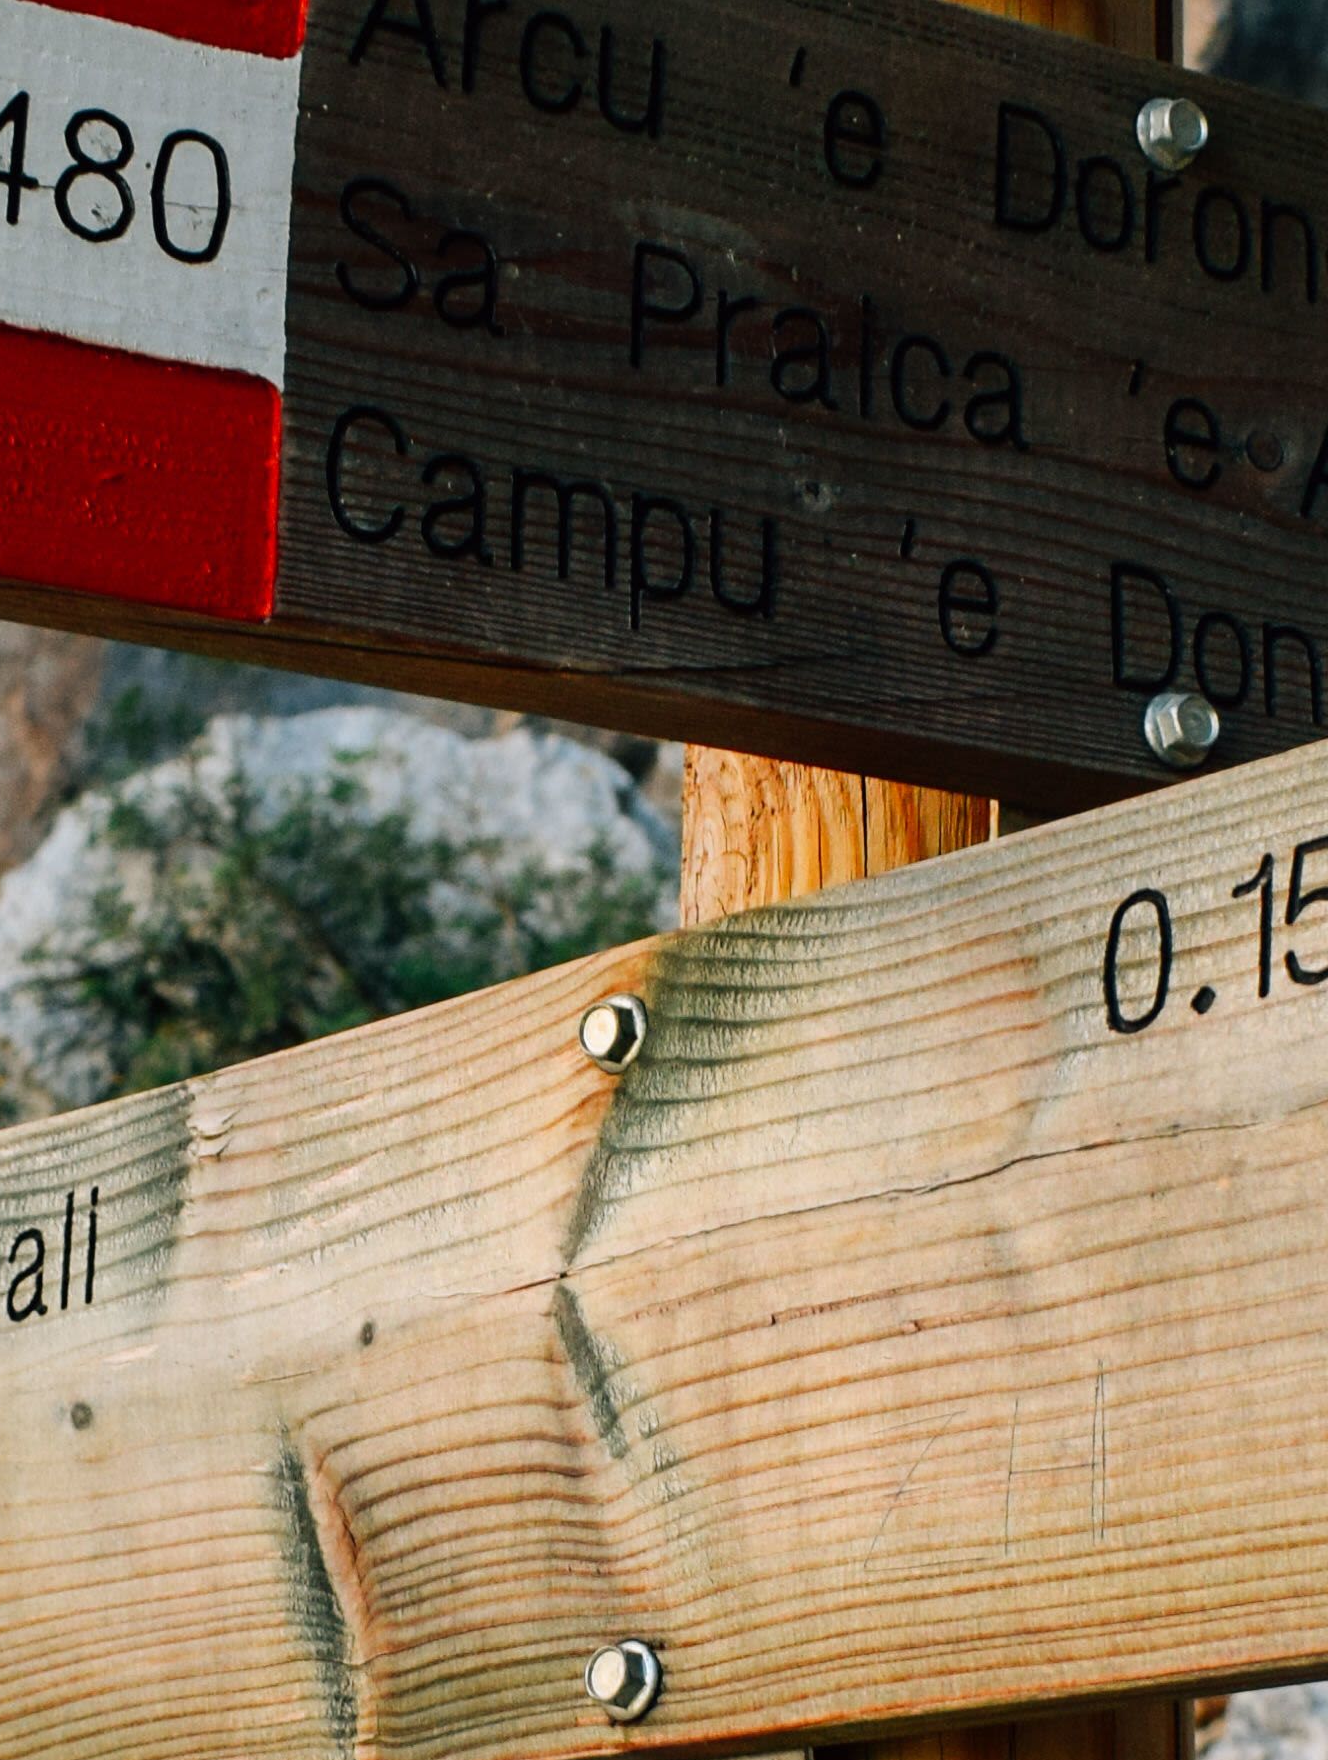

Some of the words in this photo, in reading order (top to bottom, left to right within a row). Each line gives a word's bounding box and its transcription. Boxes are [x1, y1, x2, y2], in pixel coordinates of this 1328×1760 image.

[334, 177, 505, 337] Sa
[630, 241, 1030, 452] Pralca
[327, 405, 780, 630] Campu
